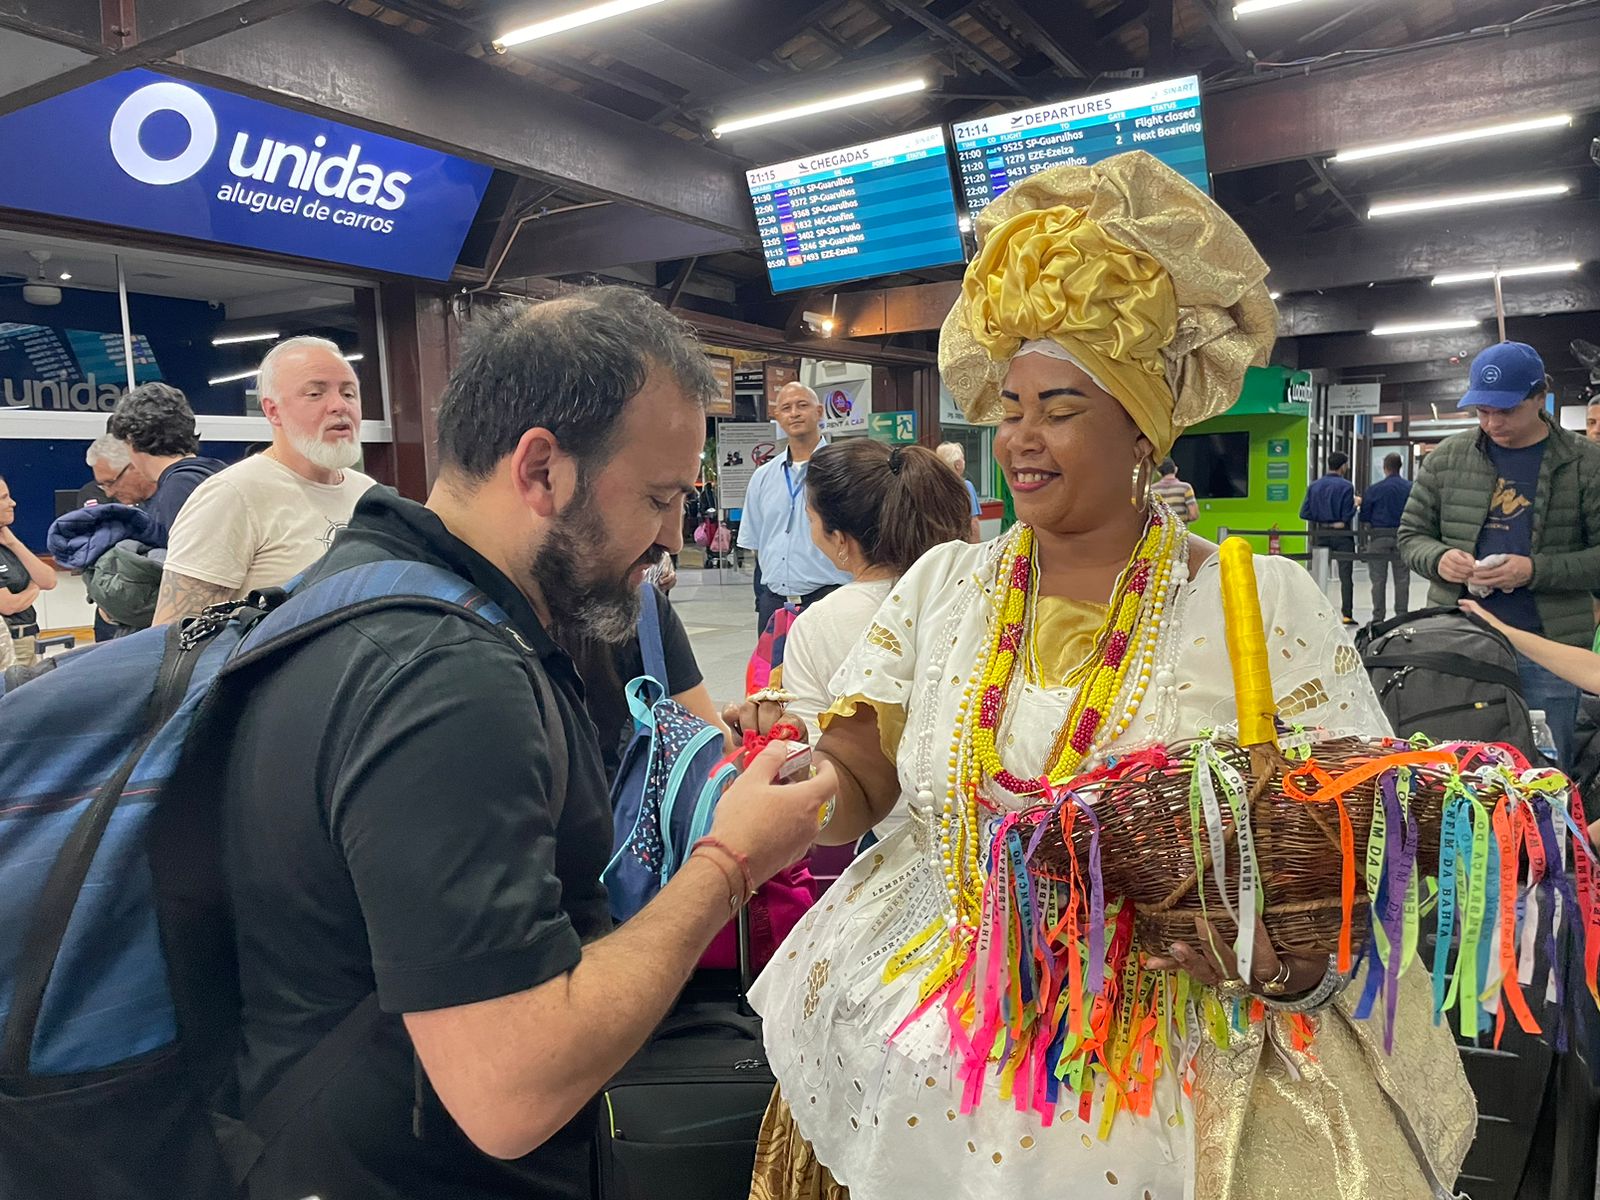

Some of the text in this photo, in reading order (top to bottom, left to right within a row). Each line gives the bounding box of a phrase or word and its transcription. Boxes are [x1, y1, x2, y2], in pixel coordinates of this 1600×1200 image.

[1163, 83, 1194, 96] SINART
[957, 98, 1112, 138] 21:14 DEPARTURES
[1151, 101, 1177, 114] STATUS
[959, 149, 982, 161] 21:00
[1002, 142, 1024, 153] 9525
[1025, 130, 1084, 149] SP-Guarulhos
[1114, 123, 1121, 132] 1
[1135, 116, 1164, 129] Flight
[1164, 107, 1196, 122] closed
[961, 161, 984, 173] 21:20
[1004, 153, 1026, 165] 1279
[1115, 135, 1123, 145] 2
[1132, 130, 1157, 142] Next
[1157, 122, 1202, 137] Boarding
[229, 132, 412, 210] unidas
[750, 148, 869, 184] 21:15 CHEGADAS
[963, 173, 986, 185] 21:20
[1006, 166, 1028, 177] 9431
[752, 193, 772, 204] 21:30
[788, 187, 806, 197] 9376
[806, 176, 854, 193] SP-Guarulhos
[754, 205, 774, 215] 22:00
[790, 197, 807, 208] 9372
[808, 188, 856, 204] SP-Guarulhos
[965, 185, 988, 197] 22:00
[967, 197, 990, 208] 22:30
[217, 182, 395, 234] aluguel de carros
[757, 215, 776, 226] 22:30
[792, 209, 811, 219] 9368
[811, 199, 859, 215] SP-Guarulhos
[760, 226, 779, 237] 22:40
[795, 220, 813, 230] 1832
[813, 212, 855, 226] MG-Confins
[762, 237, 781, 248] 23:05
[798, 231, 815, 241] 3402
[816, 226, 840, 238] SP-São
[840, 222, 861, 233] Paulo
[764, 248, 784, 258] 01:15
[799, 242, 817, 252] 3246
[818, 233, 865, 249] SP-Guarulhos
[767, 258, 786, 269] 05:00
[802, 252, 820, 263] 7493
[4, 372, 130, 411] unida
[826, 420, 843, 428] RENT
[851, 418, 865, 426] CAR
[1230, 776, 1252, 891] LEMBRANÇA DO
[1013, 849, 1022, 866] DO
[1368, 845, 1382, 866] DA
[1442, 859, 1454, 878] DA
[1439, 888, 1452, 938] BAHIA
[1121, 960, 1138, 1044] LEMBRANÇA
